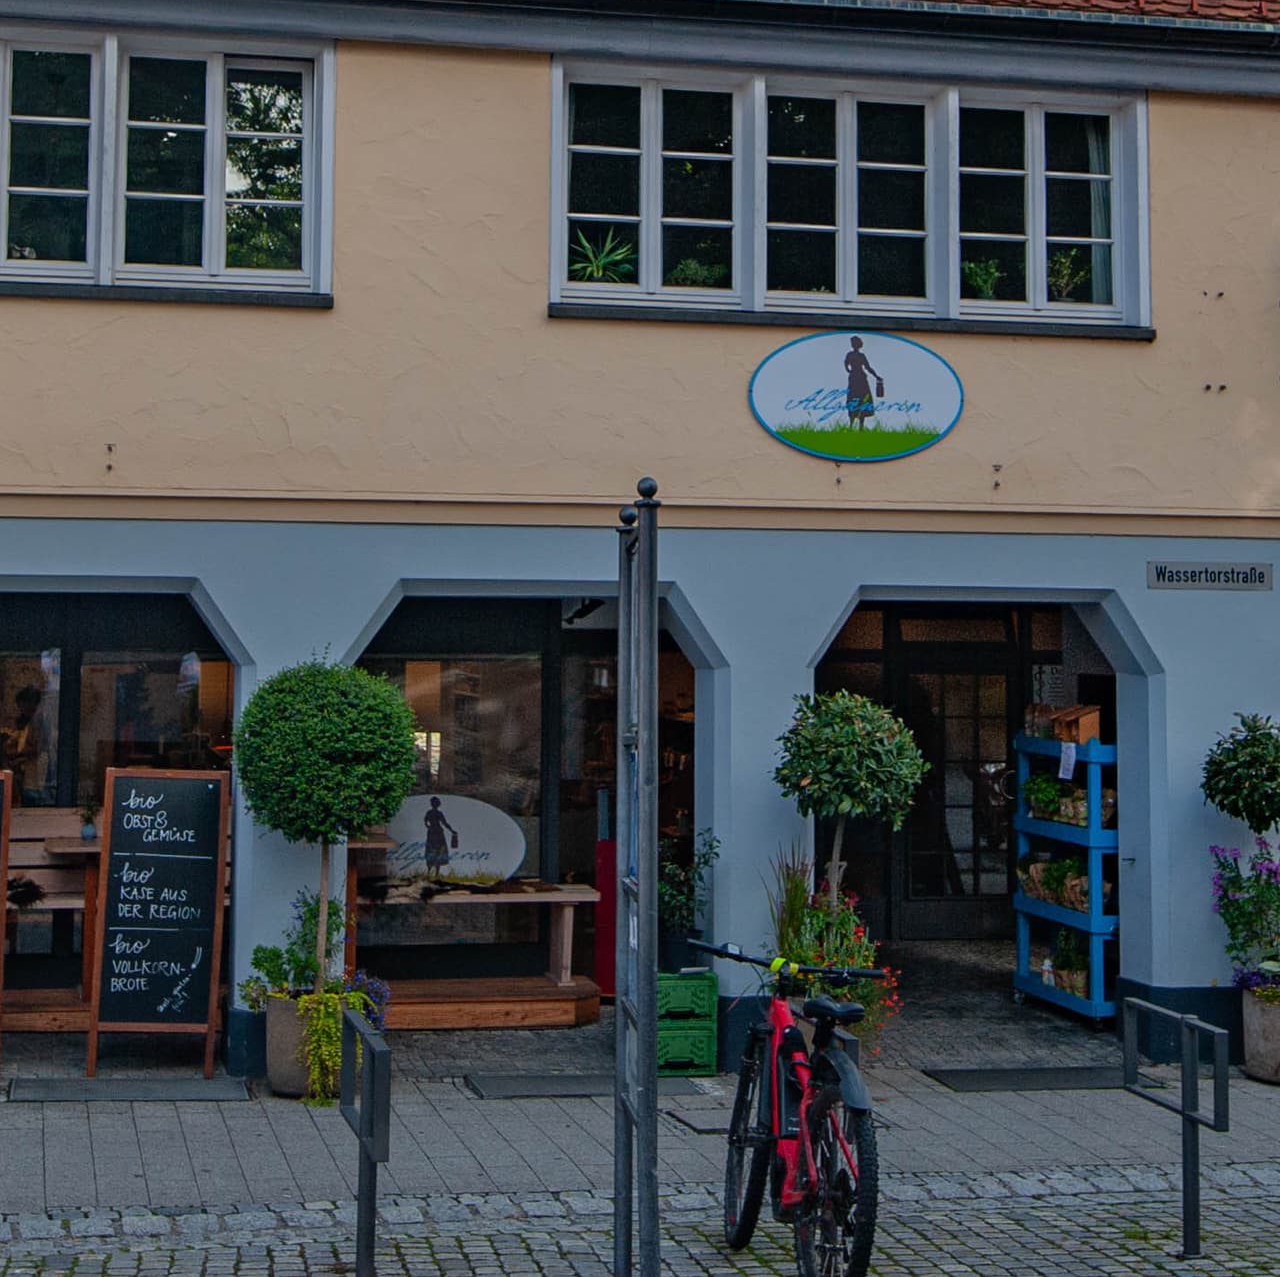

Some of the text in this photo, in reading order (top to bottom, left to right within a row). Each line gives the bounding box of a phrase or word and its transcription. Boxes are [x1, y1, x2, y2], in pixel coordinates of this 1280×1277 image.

[1155, 564, 1266, 585] Wassertorstraße
[122, 788, 164, 809] bio
[143, 827, 196, 843] GEMÜSE
[120, 862, 155, 884] bio
[160, 887, 188, 902] AUS
[117, 902, 201, 920] DER REGION
[109, 933, 151, 955] bio
[110, 977, 151, 993] BROTE
